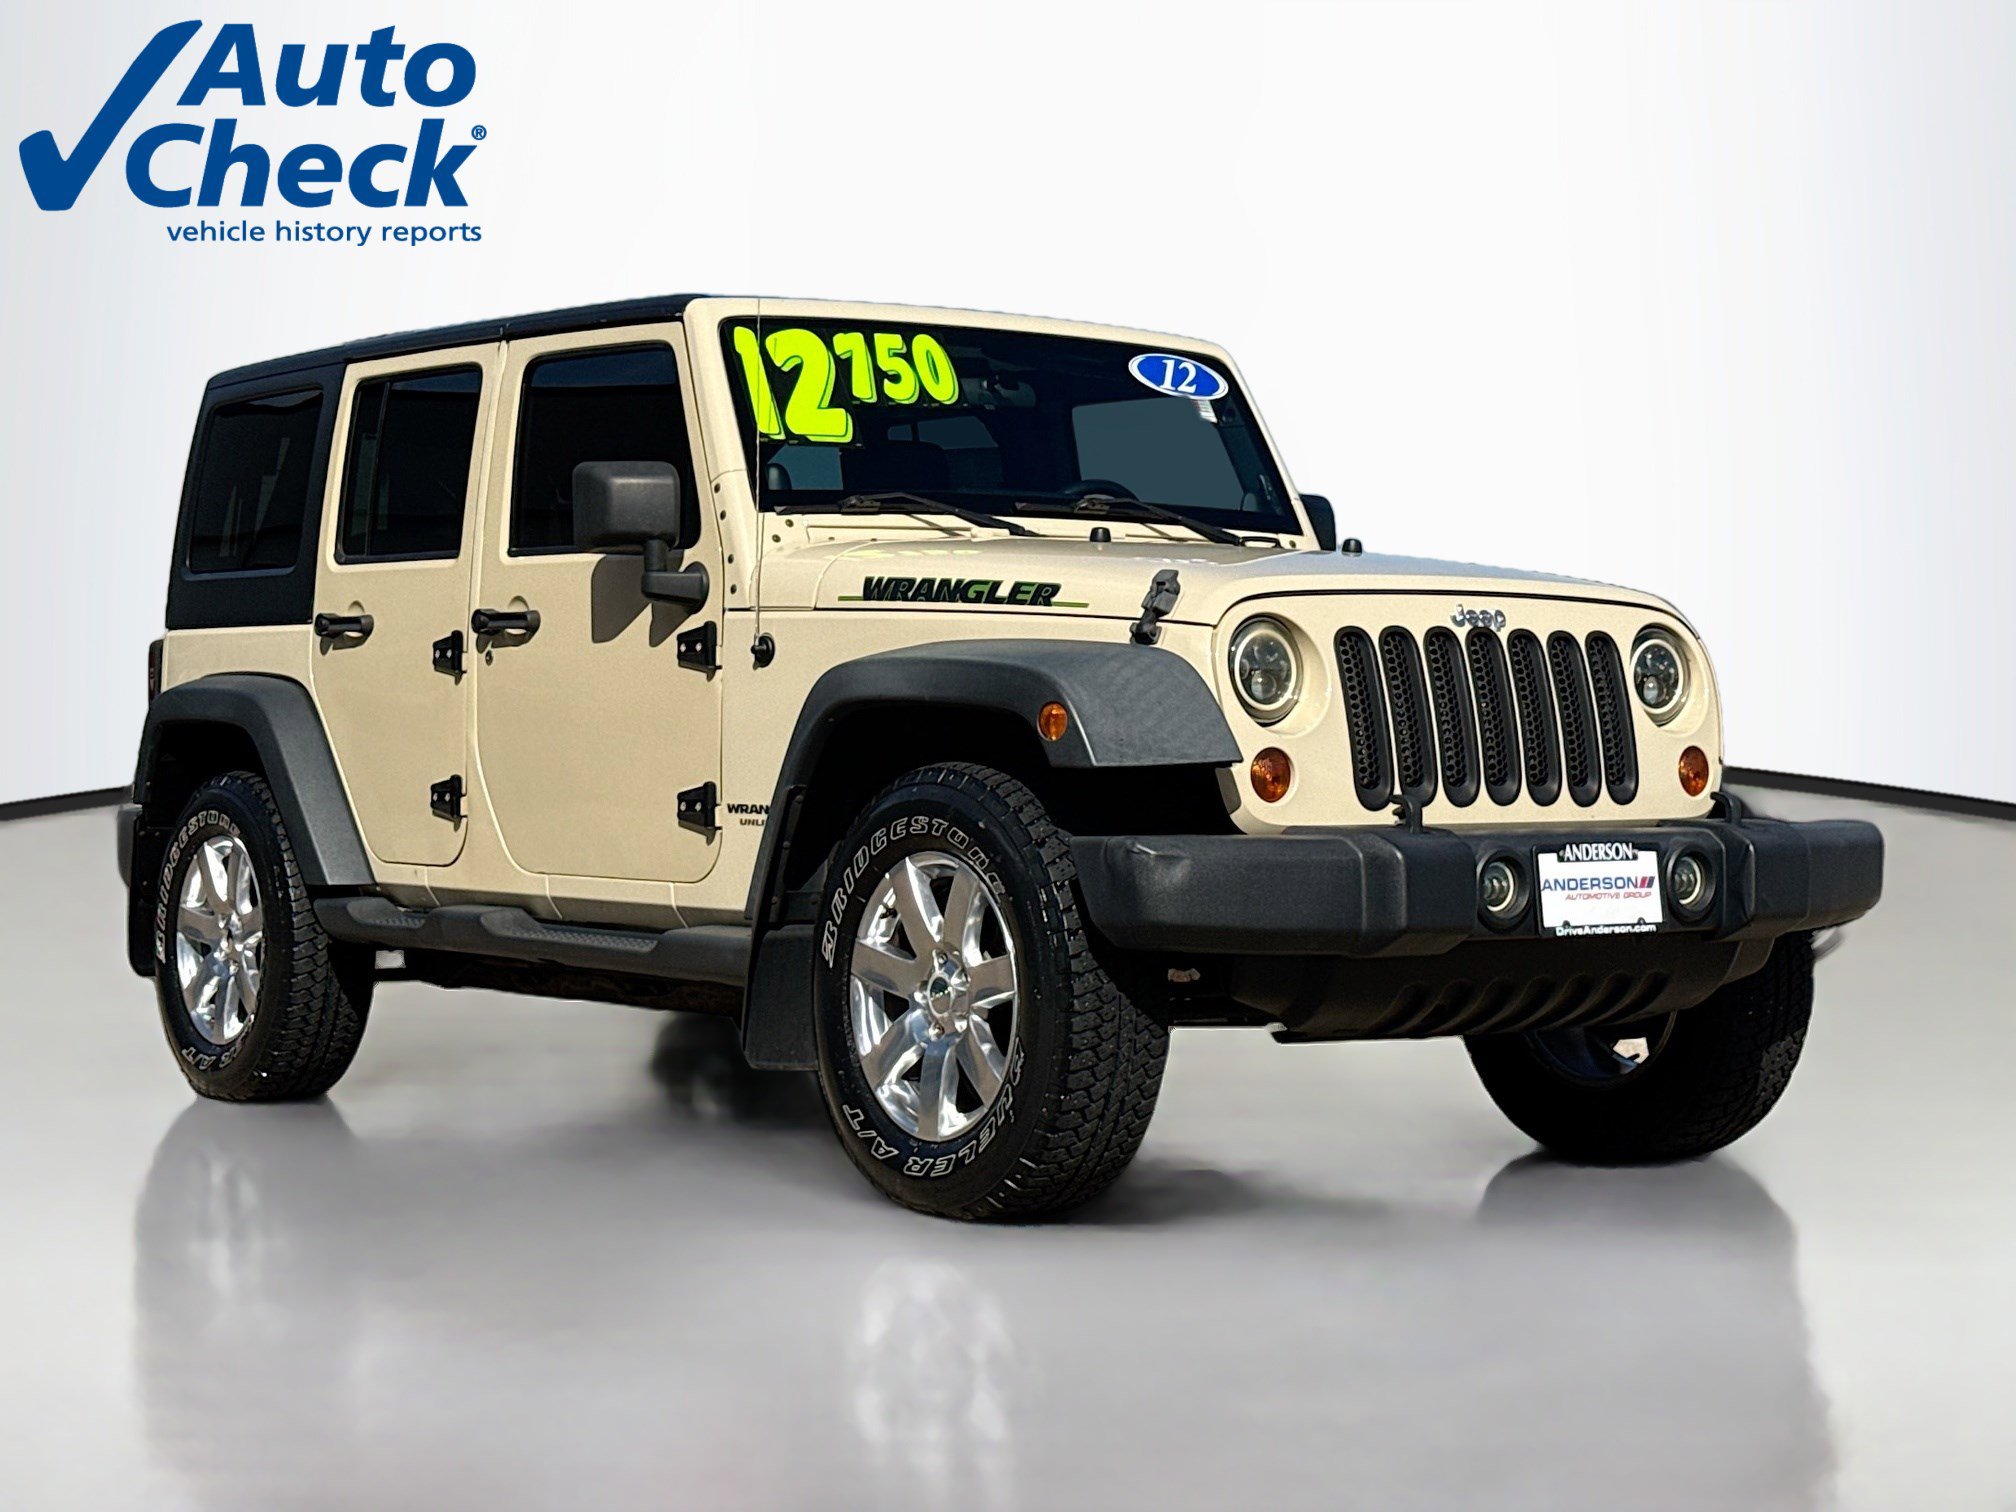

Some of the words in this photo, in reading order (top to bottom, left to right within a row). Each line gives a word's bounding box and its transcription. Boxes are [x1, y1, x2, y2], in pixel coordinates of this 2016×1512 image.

[1161, 360, 1198, 393] 12
[863, 576, 1062, 607] WRANGLER
[1450, 603, 1507, 632] Jeep
[727, 803, 770, 814] WRAN
[1564, 843, 1633, 861] ANDERSON
[822, 816, 1006, 969] BRIDGESTONE
[1541, 876, 1638, 891] ANDERSON
[1565, 892, 1620, 900] AUTOMOTIVE
[1623, 891, 1652, 899] GROUP
[1555, 923, 1657, 936] DriveAnderson.com
[842, 1104, 899, 1160] A/T
